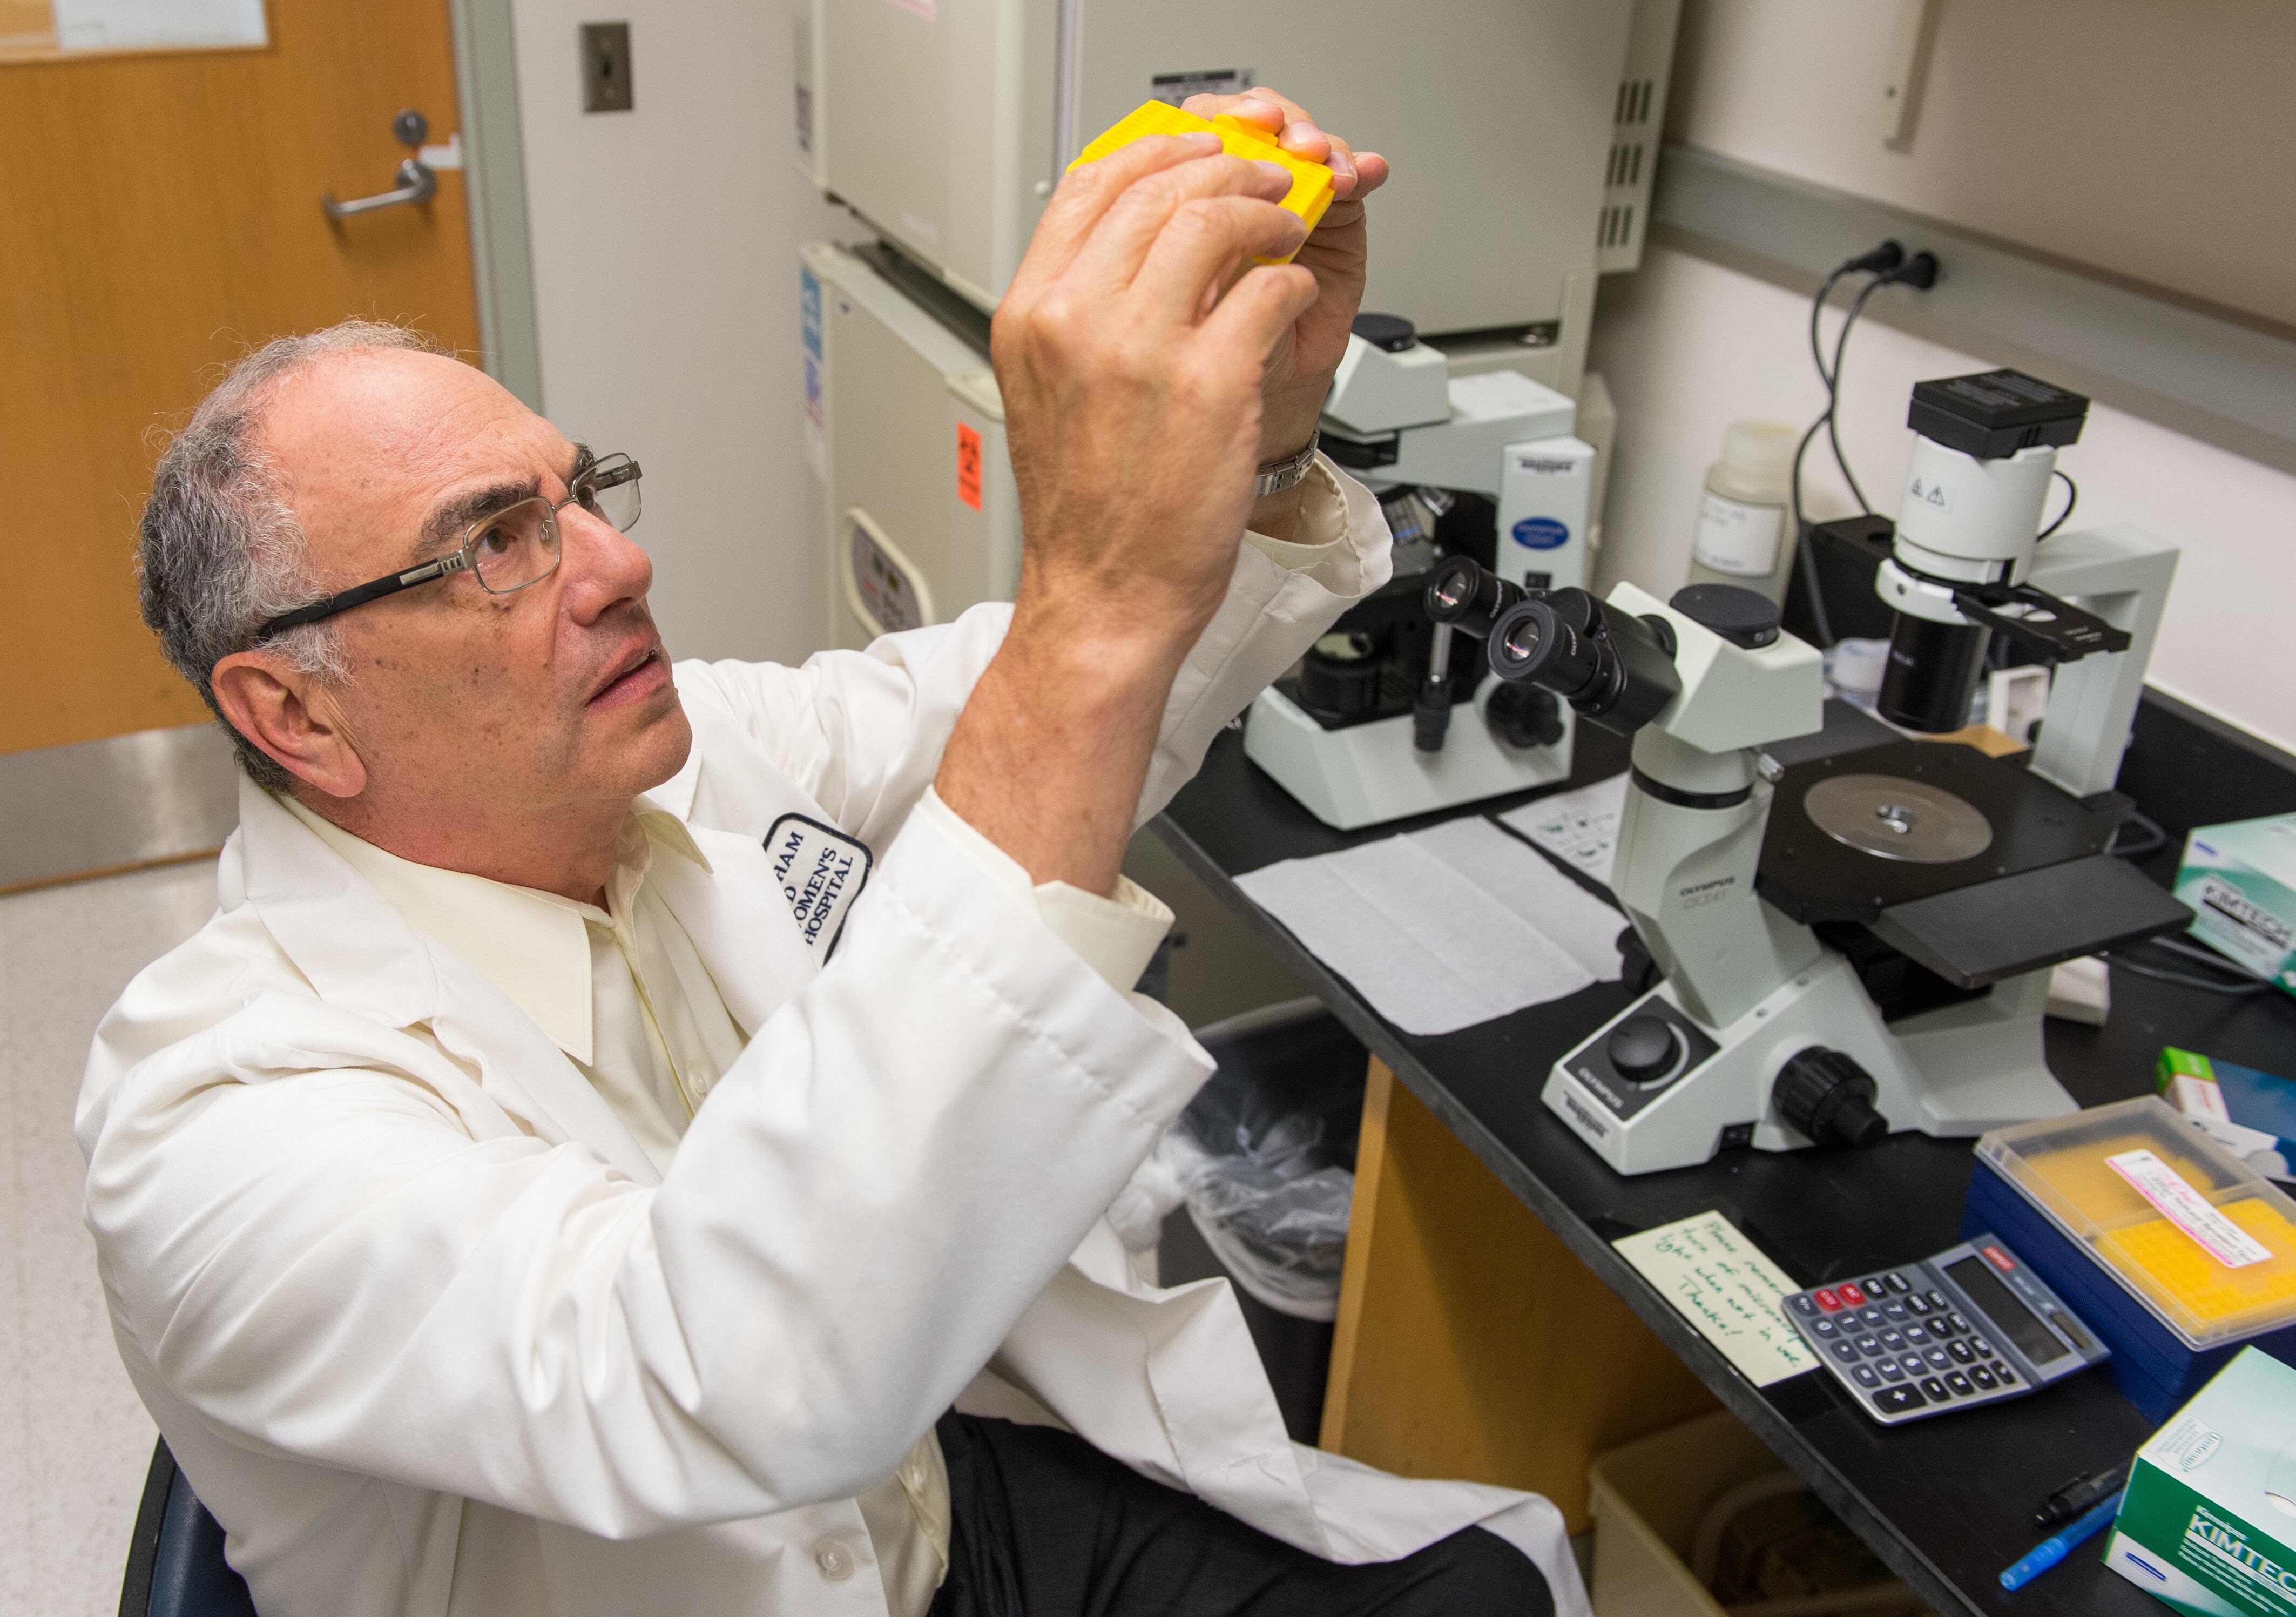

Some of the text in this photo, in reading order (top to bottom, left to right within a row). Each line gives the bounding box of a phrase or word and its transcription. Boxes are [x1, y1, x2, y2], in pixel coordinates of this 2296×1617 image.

[774, 831, 804, 881] HAM
[794, 847, 837, 928] OMEN'S
[1679, 876, 1735, 897] OLYMPUS
[804, 857, 853, 946] HOSPITAL
[1578, 1067, 1624, 1109] OLYMPUS
[1679, 1273, 1744, 1337] Thanks!
[1694, 1266, 1723, 1293] when
[1727, 1297, 1756, 1320] not
[1759, 1326, 1772, 1342] in
[1887, 1304, 1904, 1313] 7
[1738, 1283, 1811, 1352] microscop
[1842, 1316, 1856, 1324] 1
[1865, 1310, 1880, 1320] 4
[1816, 1320, 1833, 1331] 0
[1885, 1332, 1901, 1342] 5
[1907, 1327, 1923, 1337] 8
[1861, 1338, 1877, 1349] 2
[1929, 1351, 1945, 1361] 9
[1881, 1362, 1897, 1373] 3
[1905, 1357, 1921, 1367] 6
